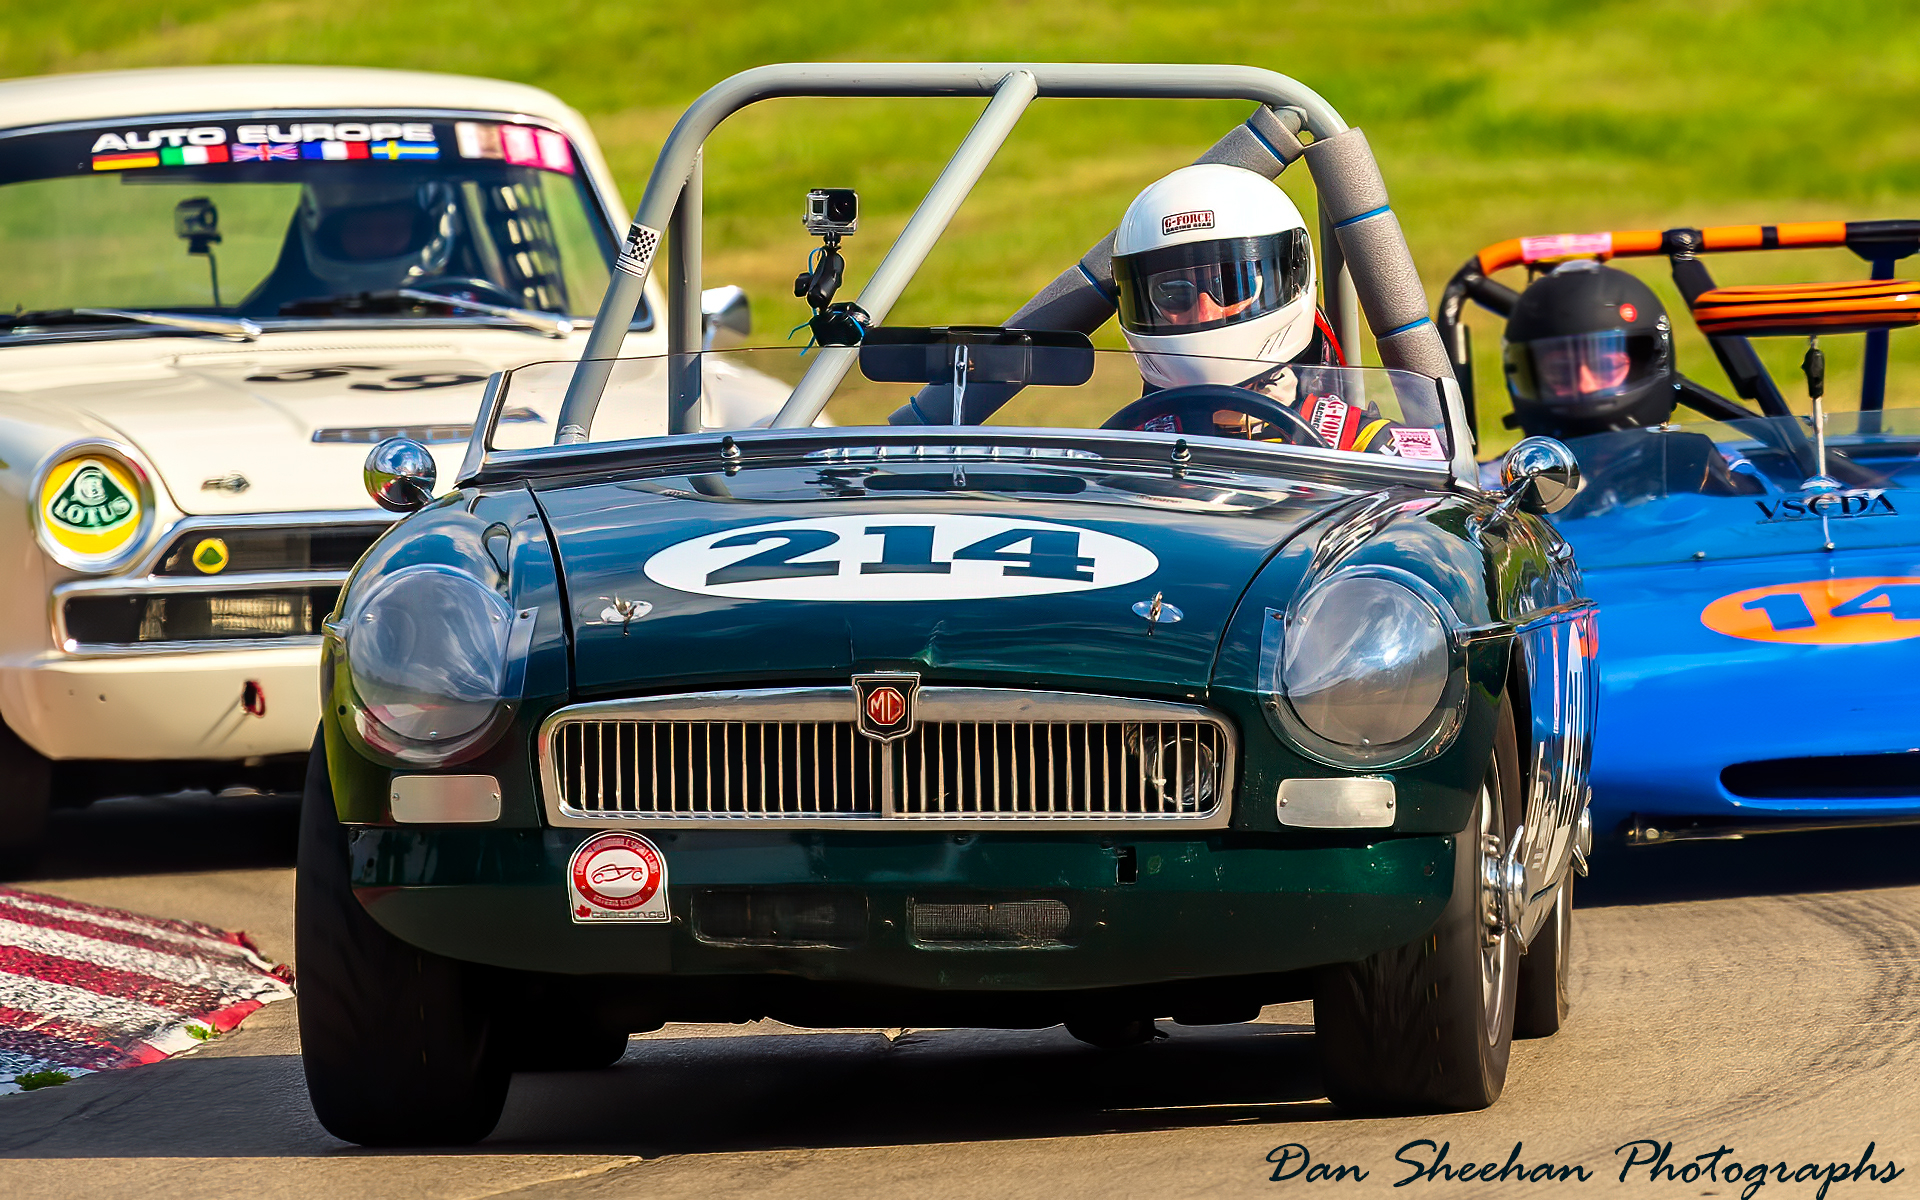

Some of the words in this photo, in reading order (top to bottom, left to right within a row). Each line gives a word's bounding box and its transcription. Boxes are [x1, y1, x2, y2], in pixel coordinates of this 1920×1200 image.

[91, 126, 227, 153] AUTO
[237, 123, 435, 144] EUROPE
[1164, 213, 1211, 228] G-FORCE
[1165, 224, 1191, 234] RACING
[54, 496, 131, 526] LOTUS
[704, 525, 1096, 586] 214
[1741, 584, 1920, 632] 14
[870, 691, 903, 722] MG
